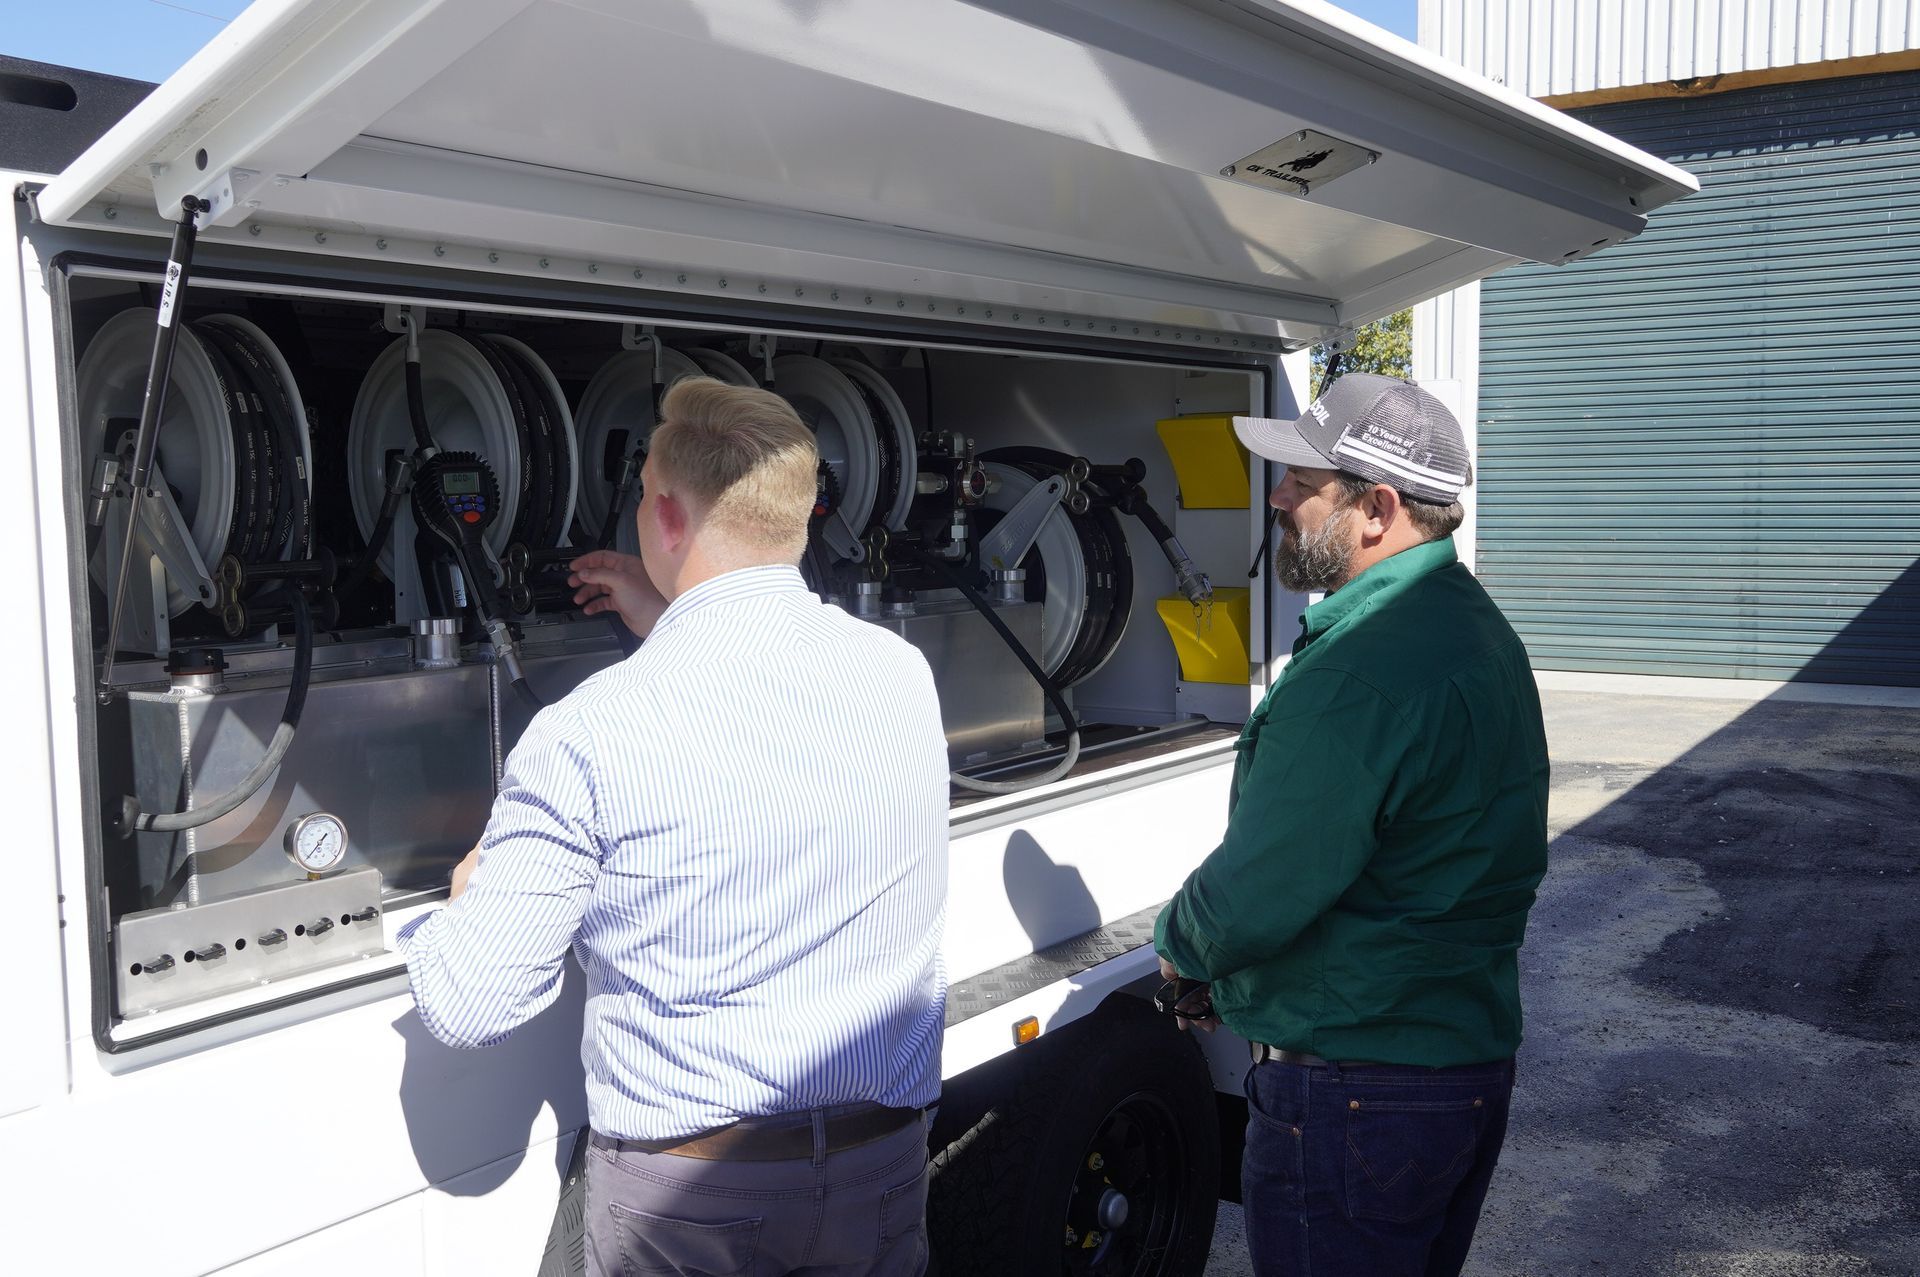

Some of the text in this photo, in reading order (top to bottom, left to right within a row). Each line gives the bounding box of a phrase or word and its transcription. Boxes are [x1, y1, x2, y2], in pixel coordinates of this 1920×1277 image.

[1261, 169, 1311, 185] TRAILERS
[1361, 432, 1408, 456] Excellence
[1367, 424, 1416, 449] 10 Years of
